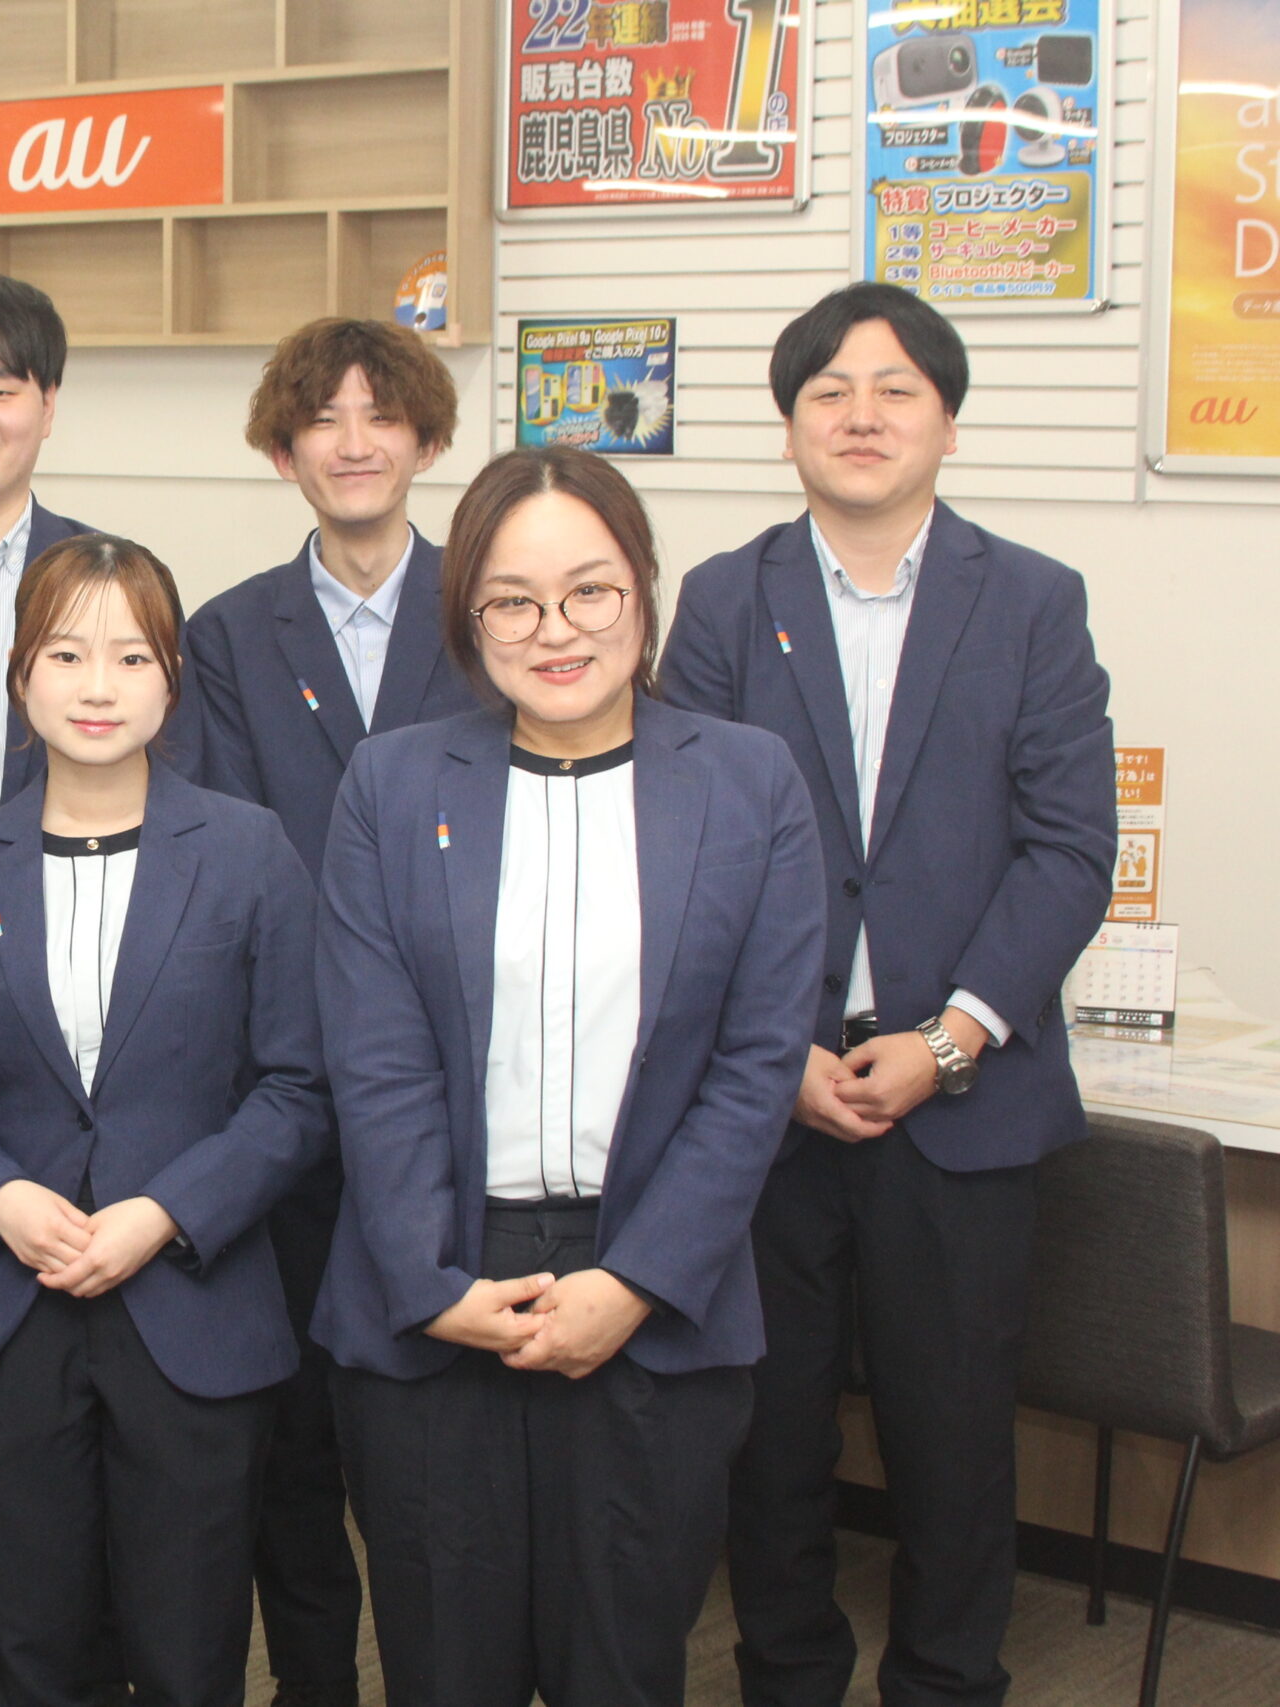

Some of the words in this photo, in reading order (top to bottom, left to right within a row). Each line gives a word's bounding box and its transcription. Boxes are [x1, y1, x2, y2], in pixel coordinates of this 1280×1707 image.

[521, 58, 632, 101] 販売台数
[8, 114, 152, 192] au
[519, 107, 632, 182] 鹿児島県
[883, 187, 929, 214] 特賞
[934, 182, 1066, 212] プロジェクター
[930, 216, 1076, 239] コーヒーメーカー
[929, 241, 1050, 260] サーキュレーター
[929, 261, 1074, 280] Bluetoothスピーカー
[526, 332, 555, 349] Google
[557, 330, 578, 345] Pixel
[594, 328, 624, 345] Google
[626, 325, 647, 342] Pixel
[1190, 396, 1258, 424] au
